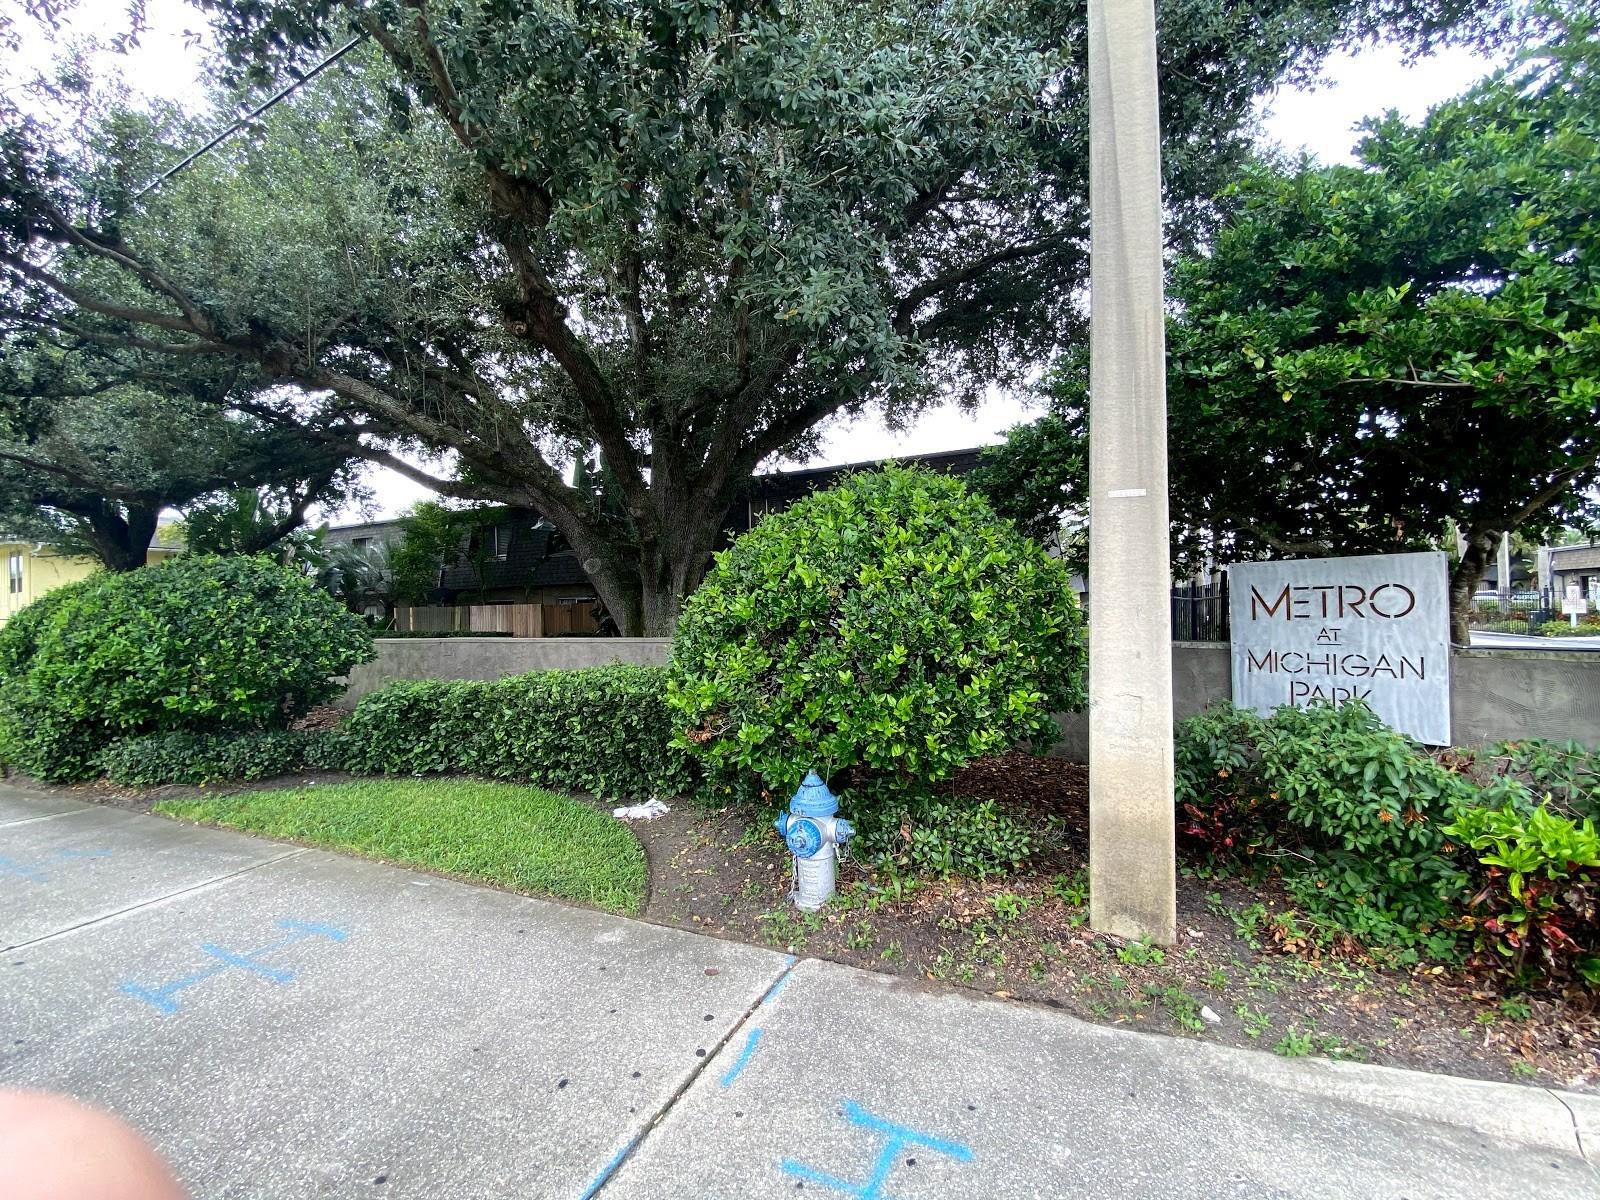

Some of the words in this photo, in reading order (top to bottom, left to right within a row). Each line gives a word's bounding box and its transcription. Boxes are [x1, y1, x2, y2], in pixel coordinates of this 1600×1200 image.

[1251, 583, 1416, 621] METRO
[1317, 627, 1342, 642] AT
[1247, 648, 1426, 680] MICHIGAN
[1290, 681, 1373, 712] PARK
